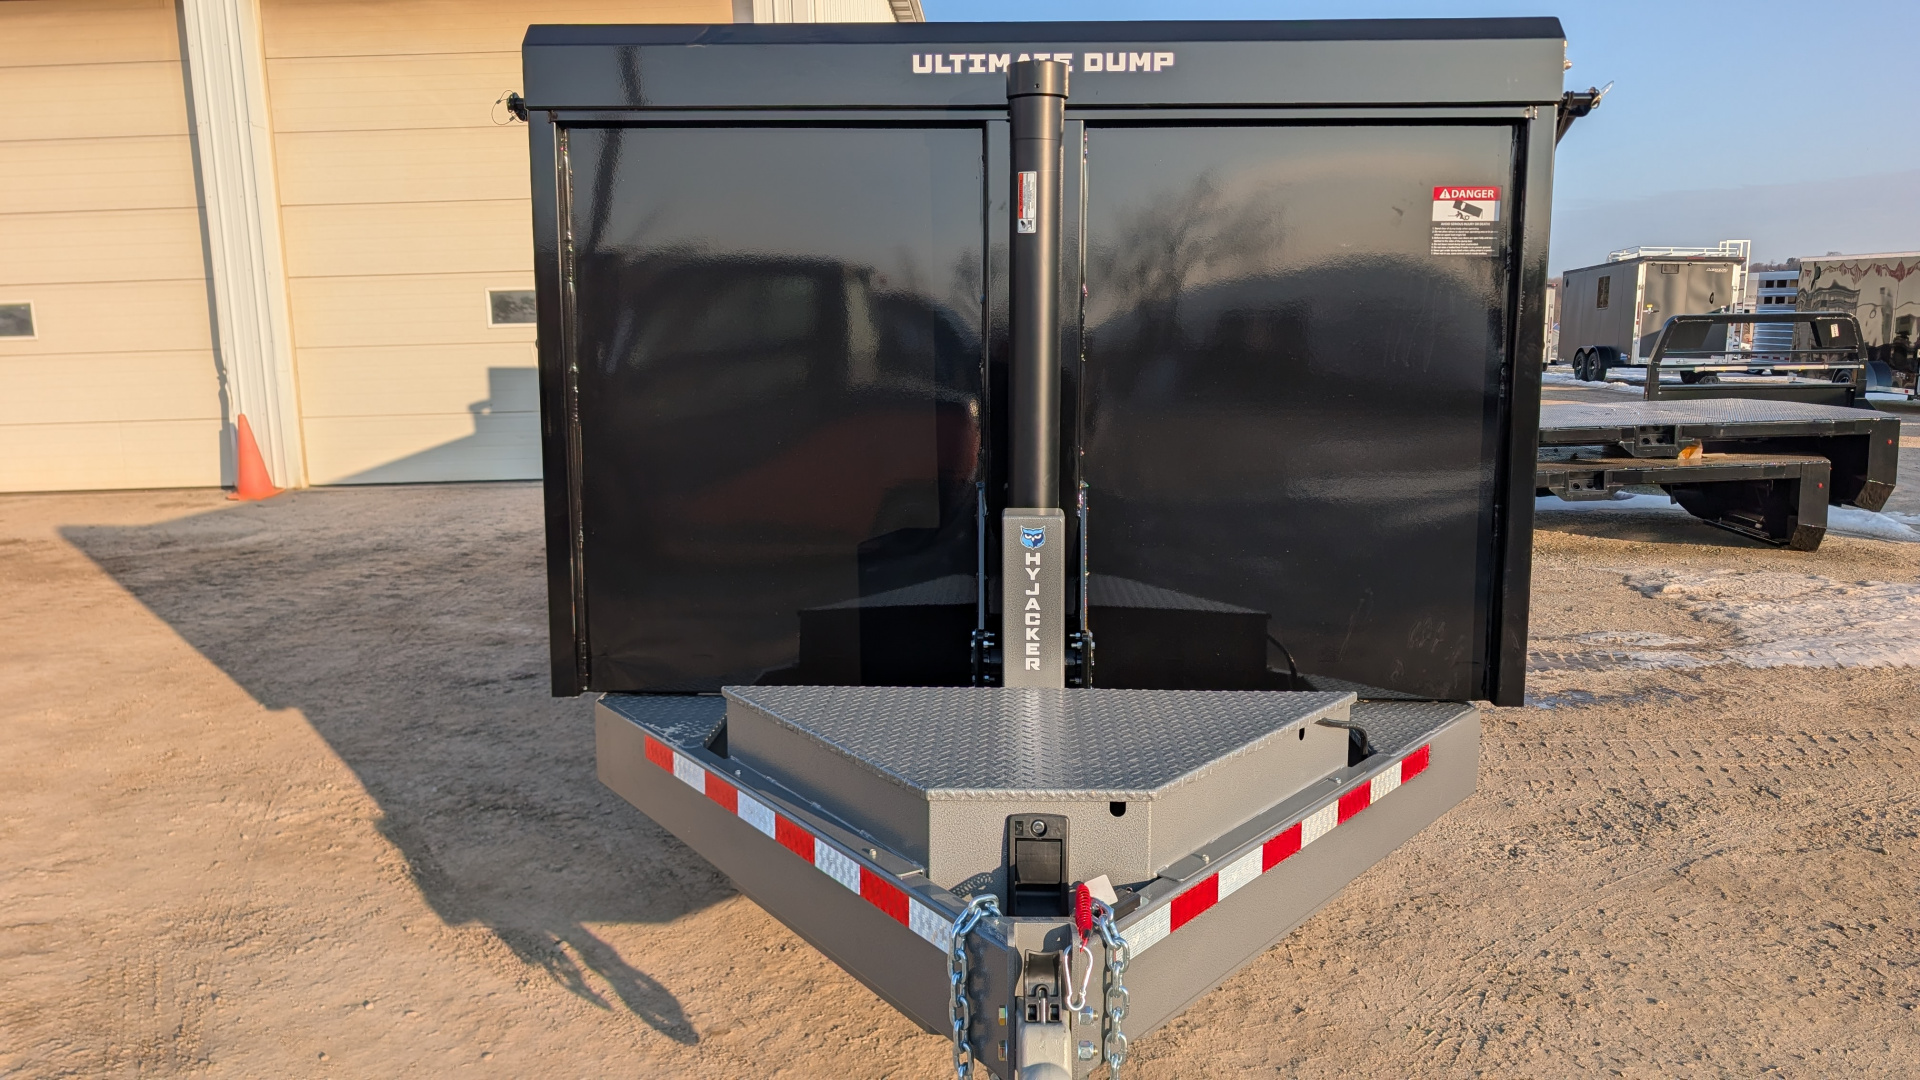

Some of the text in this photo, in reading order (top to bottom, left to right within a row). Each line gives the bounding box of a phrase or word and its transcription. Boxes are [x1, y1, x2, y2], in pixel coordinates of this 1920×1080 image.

[1083, 52, 1174, 72] DUMP
[1451, 189, 1494, 199] DANGER
[1024, 552, 1041, 671] HYJACKER
